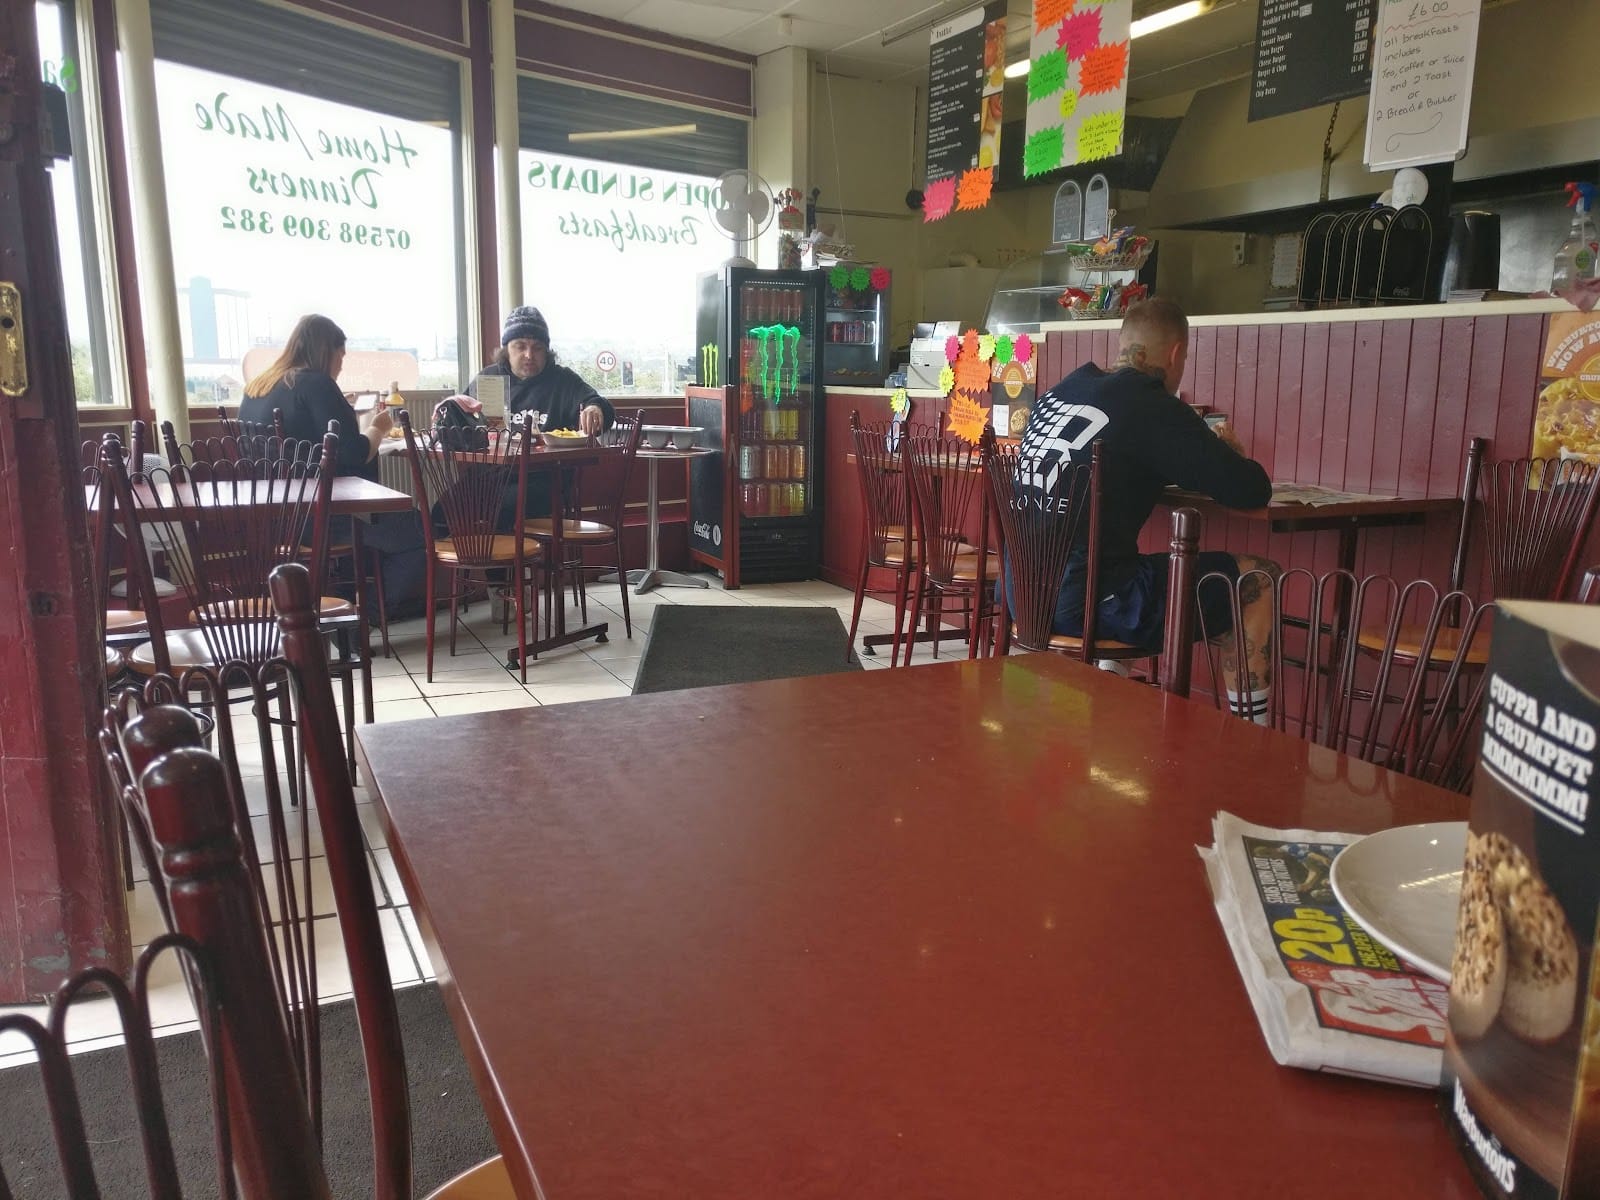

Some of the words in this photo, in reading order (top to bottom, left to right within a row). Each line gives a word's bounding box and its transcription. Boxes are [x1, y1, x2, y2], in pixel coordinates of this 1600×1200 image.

[1408, 2, 1449, 21] £6.00
[1402, 25, 1460, 44] breakfasts
[1384, 46, 1421, 63] includes
[1413, 75, 1421, 85] 2
[1407, 90, 1421, 101] or
[1376, 109, 1383, 121] 2
[1387, 103, 1415, 120] Bread
[1426, 93, 1457, 109] Butter
[600, 356, 614, 366] 40
[1555, 338, 1584, 372] NOW
[1490, 672, 1539, 727] CUPPA
[1541, 705, 1597, 754] AND
[1493, 712, 1594, 786] CRUMPET
[1253, 856, 1271, 870] OUT
[1262, 886, 1284, 904] STARS
[1282, 892, 1302, 904] FOR
[1350, 931, 1381, 968] CHEAPER
